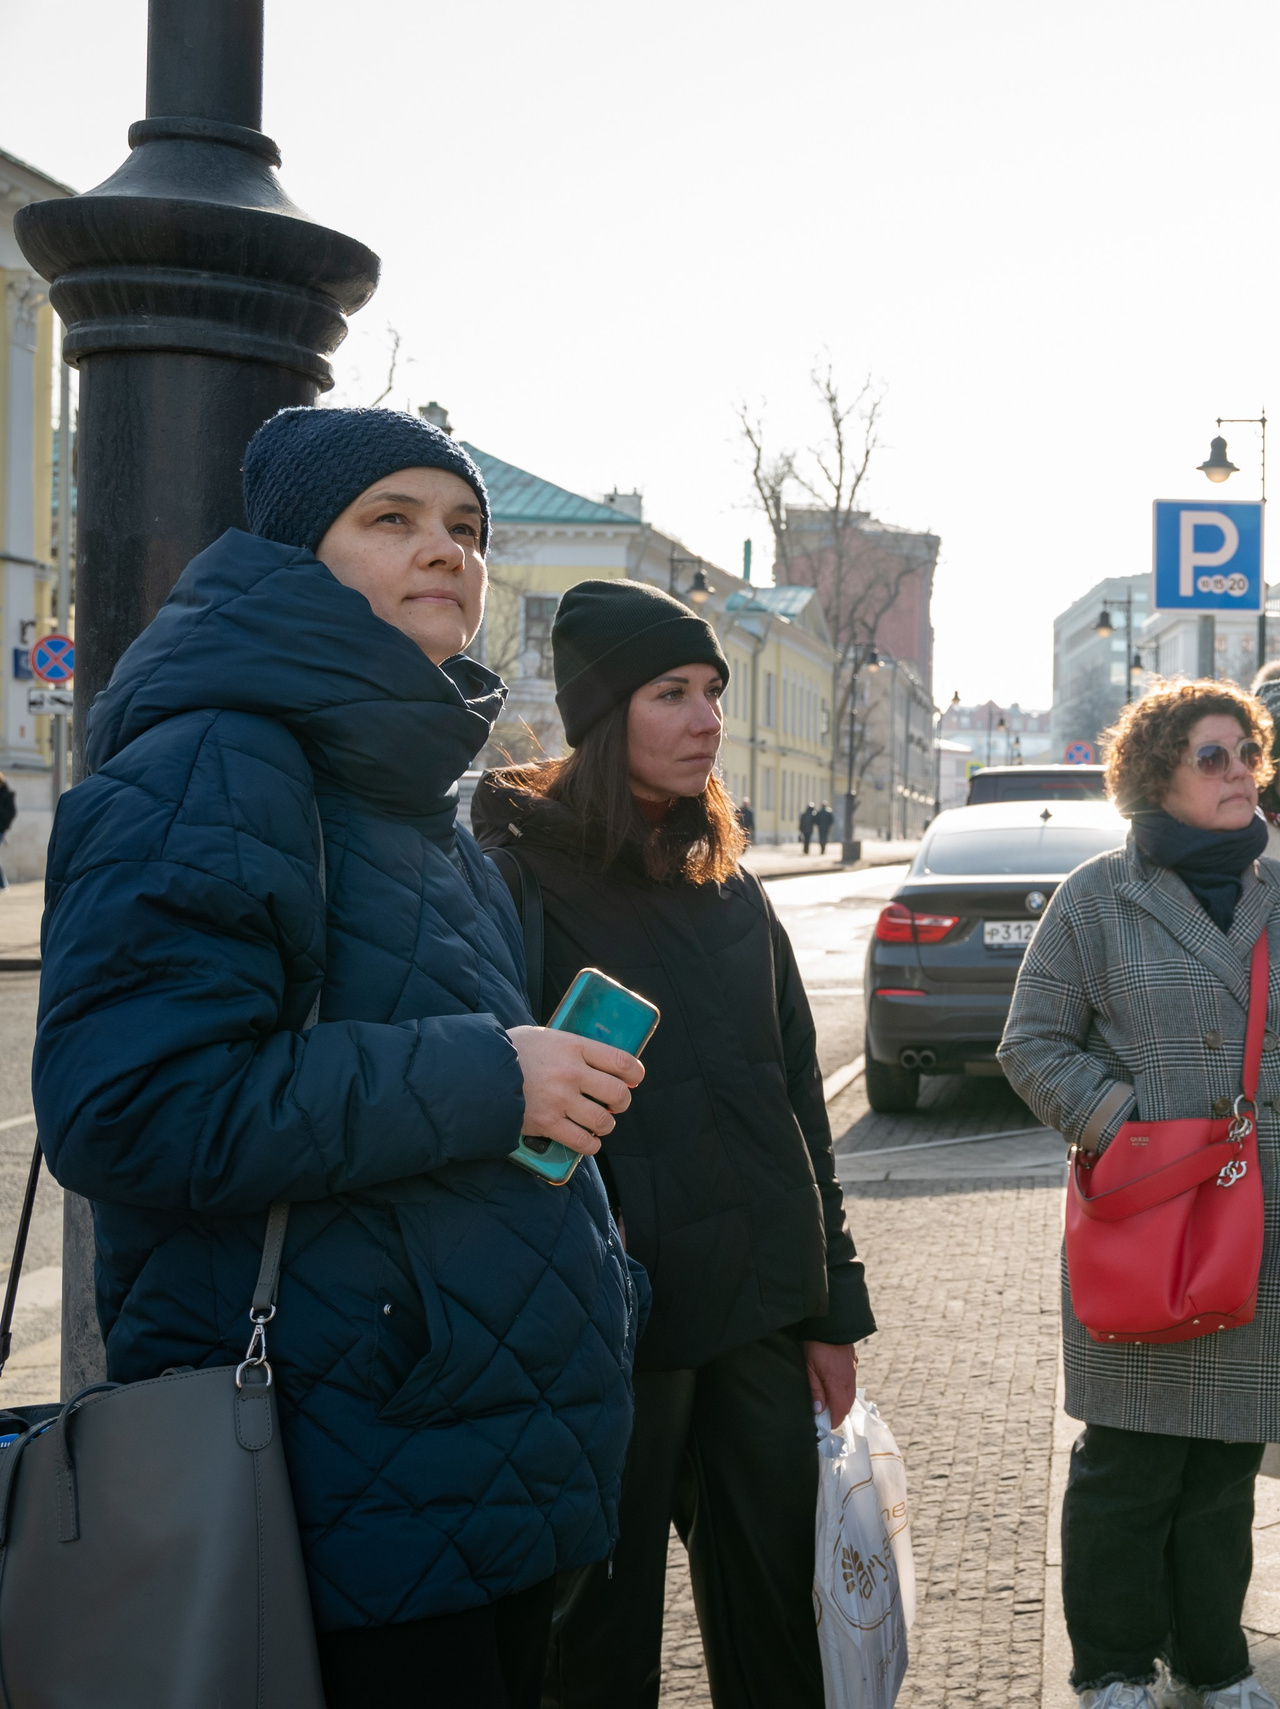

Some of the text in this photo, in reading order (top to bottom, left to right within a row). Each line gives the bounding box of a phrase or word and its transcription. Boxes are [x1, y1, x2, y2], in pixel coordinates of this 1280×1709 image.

[1179, 510, 1239, 597] P
[1213, 578, 1225, 591] 15
[1228, 577, 1246, 591] 20
